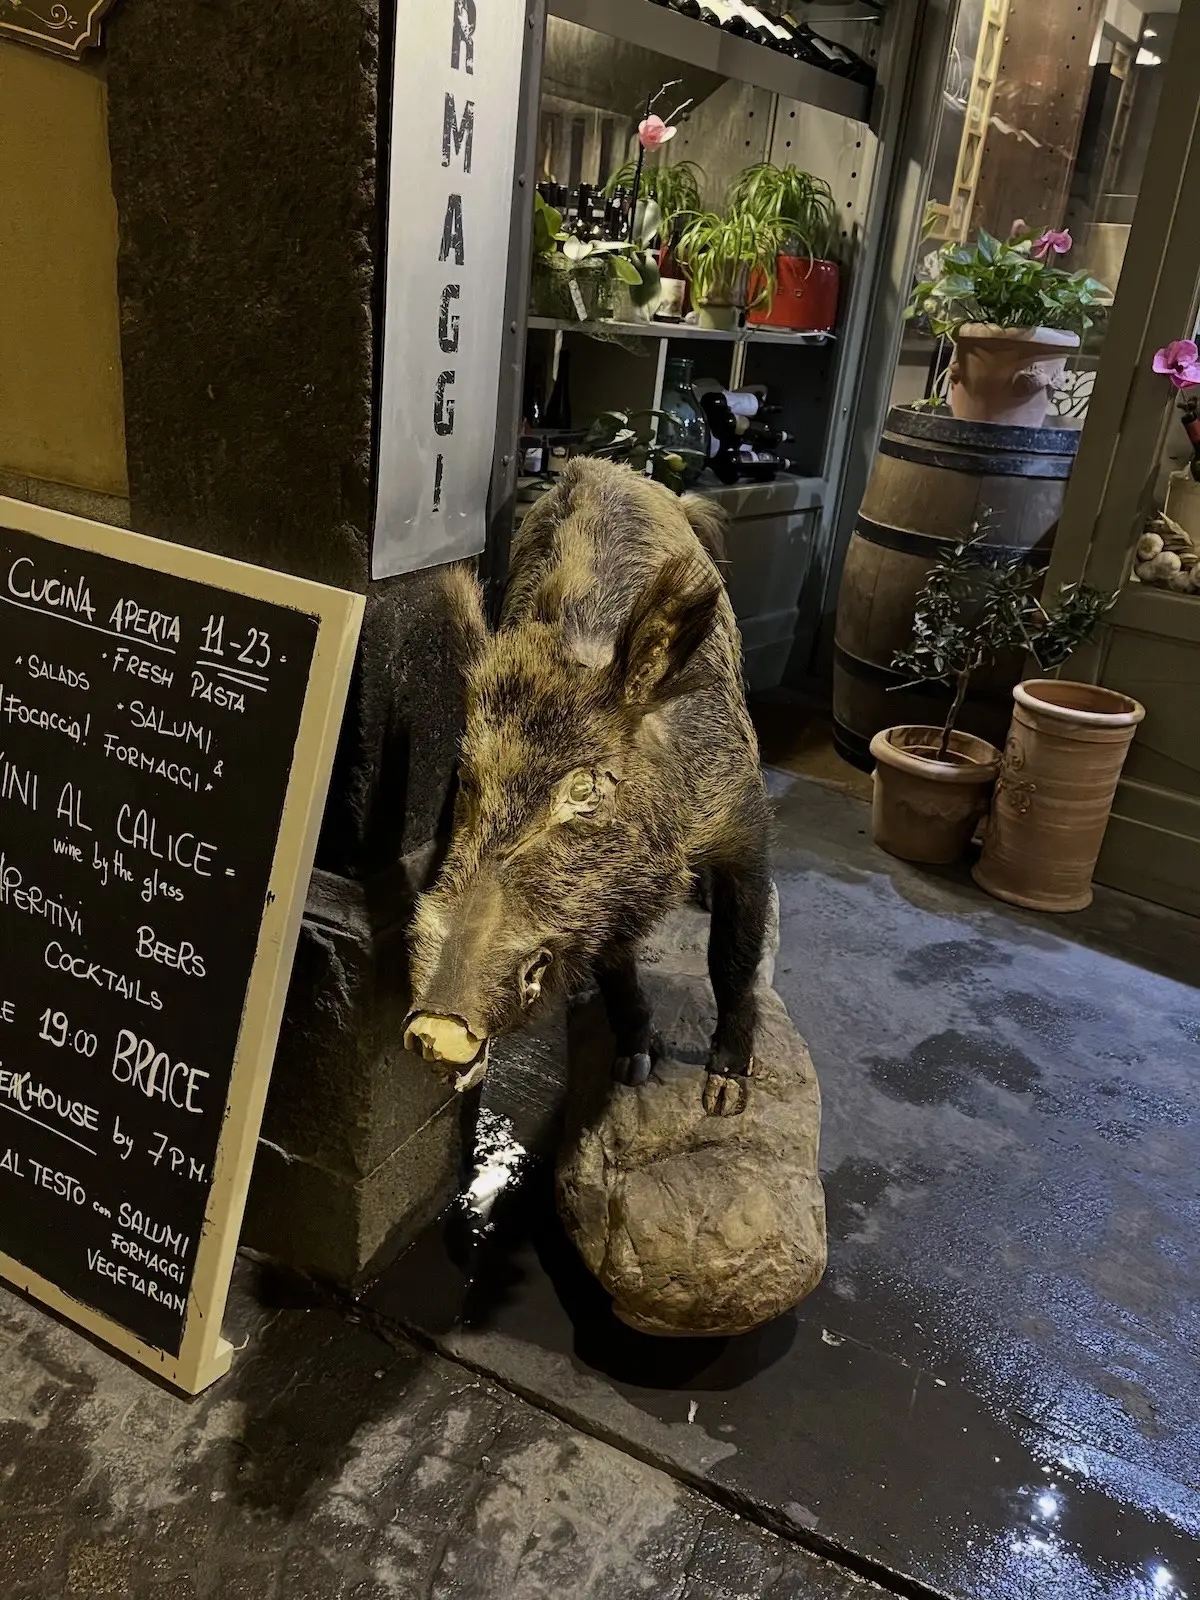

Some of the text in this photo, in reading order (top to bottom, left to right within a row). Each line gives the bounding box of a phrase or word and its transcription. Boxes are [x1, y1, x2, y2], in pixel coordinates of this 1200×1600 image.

[108, 597, 181, 643] APERTA
[28, 654, 90, 691] SALADS
[112, 647, 246, 714] FRESH PASTA
[103, 733, 199, 793] FORMAGGI
[129, 700, 224, 778] SALUMI &
[0, 751, 218, 877] INI AL CALICE
[53, 838, 185, 903] wine by the glass
[44, 941, 163, 1011] COCKTAILS
[135, 925, 206, 978] BEERS
[38, 1007, 98, 1058] 19:00
[111, 1029, 210, 1114] BRACE
[0, 1060, 100, 1132] EAKHOUSE
[112, 1115, 134, 1159] by
[0, 1148, 190, 1259] AL TESTO con SALUMI
[87, 1248, 186, 1316] VEGETARIAN
